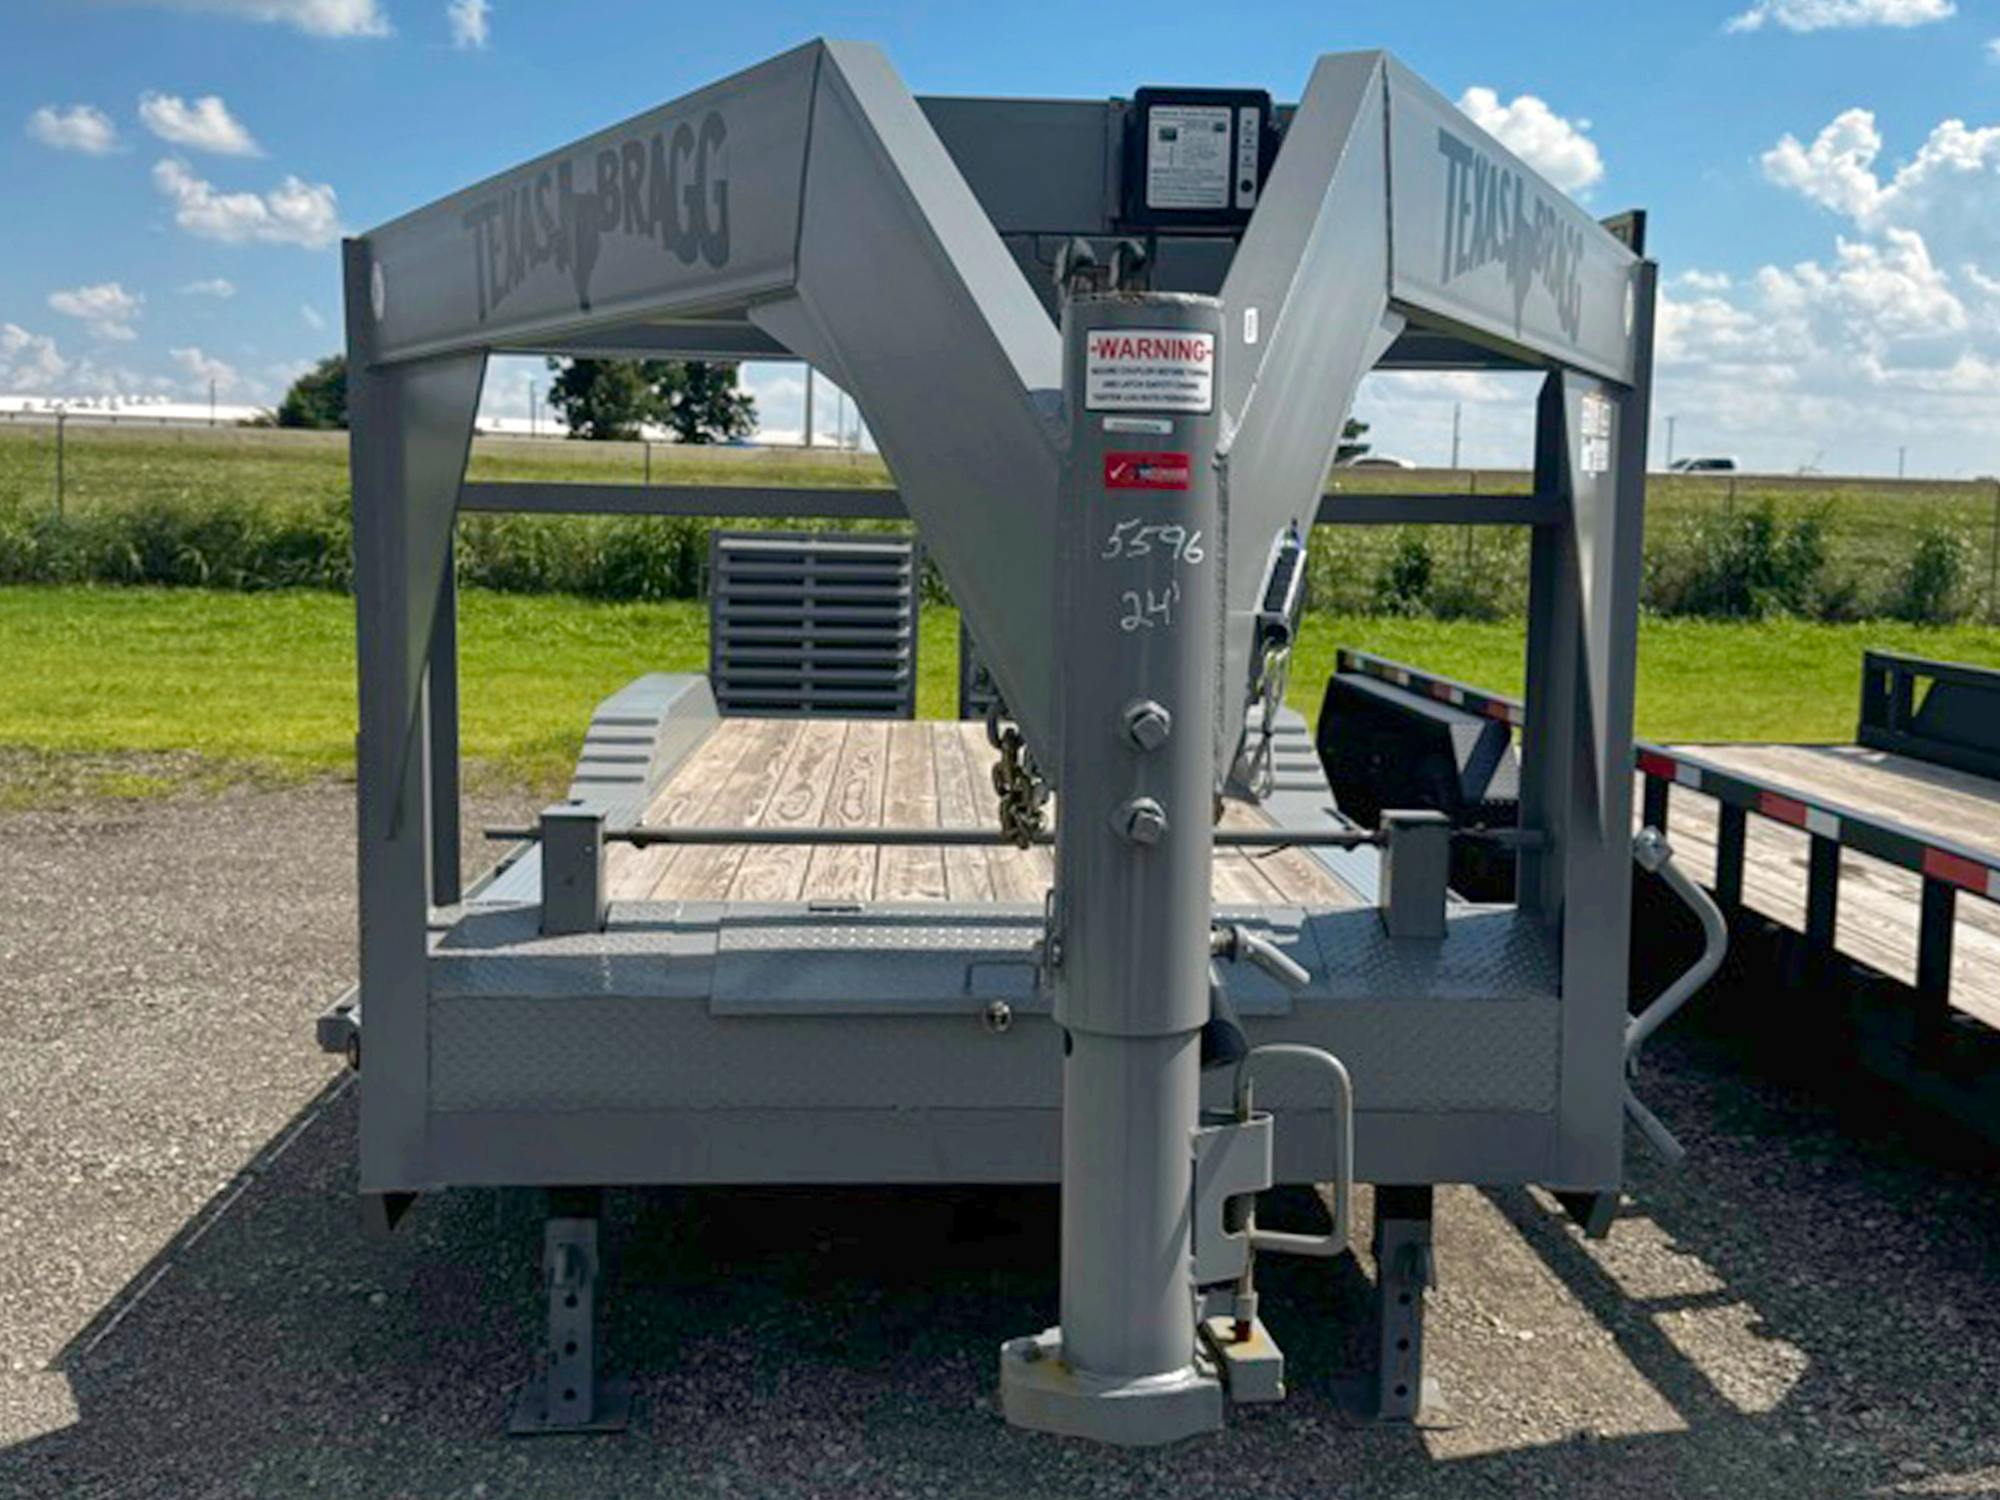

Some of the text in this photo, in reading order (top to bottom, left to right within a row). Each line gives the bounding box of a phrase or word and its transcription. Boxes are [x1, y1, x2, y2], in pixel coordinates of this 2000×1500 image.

[461, 110, 731, 323] TEXAS BRAGG
[1438, 127, 1512, 286] TEXAS
[1101, 518, 1204, 564] 5596
